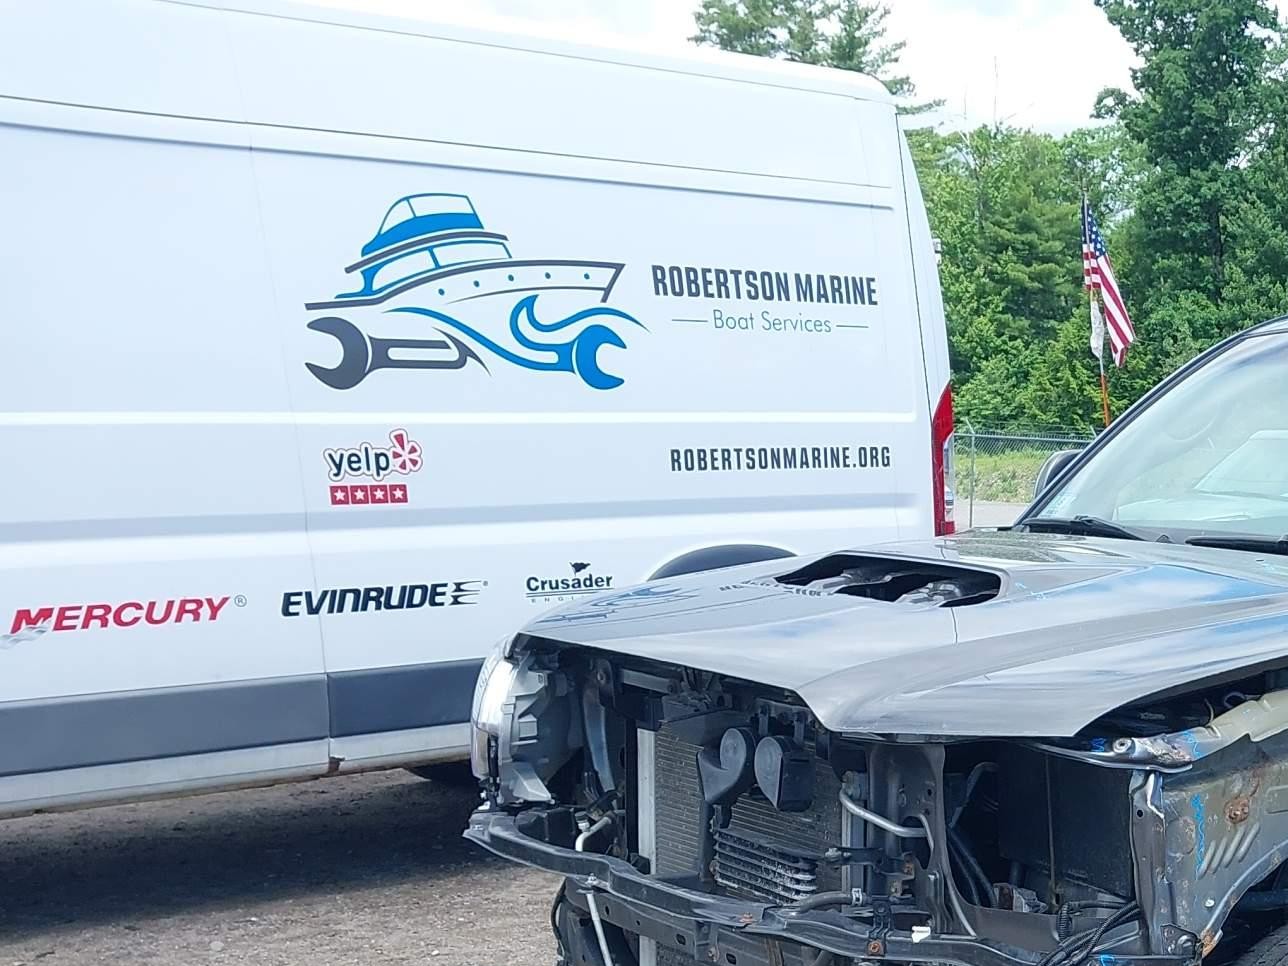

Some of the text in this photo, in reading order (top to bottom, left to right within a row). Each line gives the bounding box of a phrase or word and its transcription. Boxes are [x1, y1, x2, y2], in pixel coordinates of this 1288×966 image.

[651, 264, 879, 306] ROBERTSON MARINE
[712, 309, 832, 333] Boat Services
[327, 446, 390, 477] yelp
[670, 446, 891, 472] ROBERTSONMARINE.ORG
[525, 573, 613, 591] Crusader
[281, 582, 449, 617] EVINRUDE
